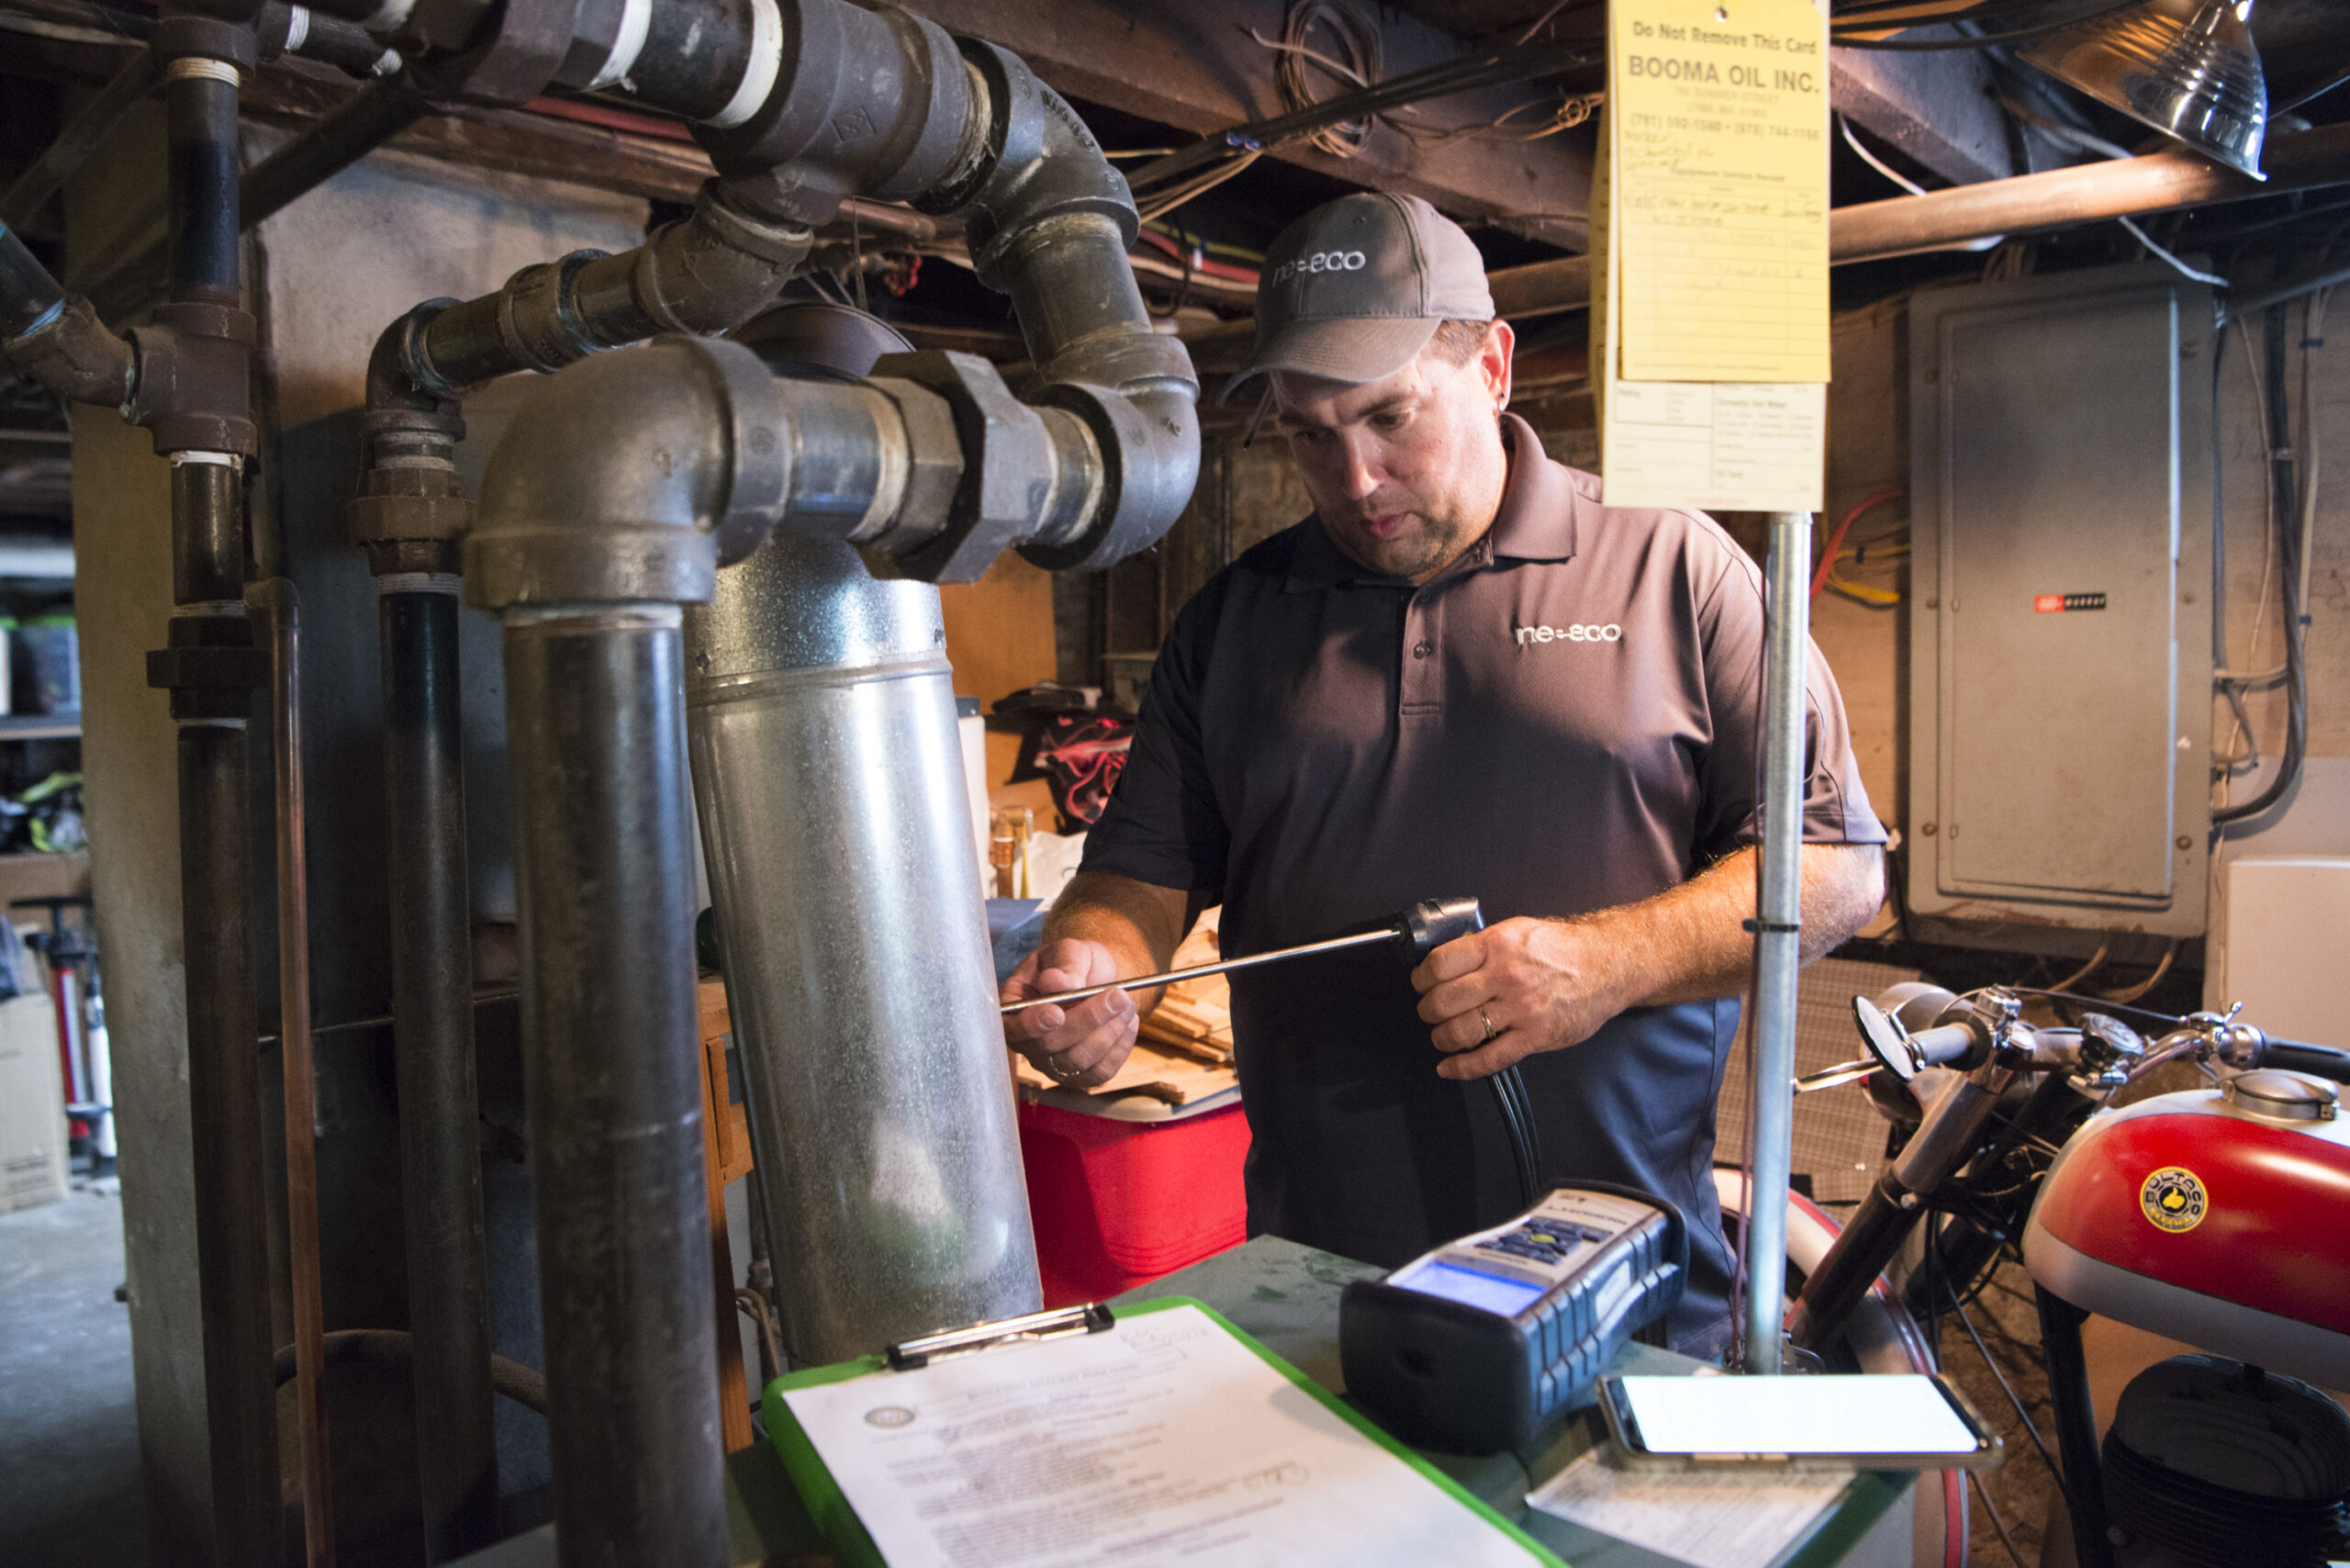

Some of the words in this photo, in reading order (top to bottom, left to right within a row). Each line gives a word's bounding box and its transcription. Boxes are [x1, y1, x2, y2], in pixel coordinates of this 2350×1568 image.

[1632, 21, 1653, 38] Do
[1659, 24, 1686, 41] Not
[1691, 28, 1748, 48] Remove
[1753, 34, 1781, 51] This
[1786, 38, 1818, 55] Card
[1628, 55, 1721, 85] BOOMA
[1729, 65, 1766, 89] OIL
[1774, 70, 1820, 95] INC.
[2145, 1172, 2202, 1215] BULTACO
